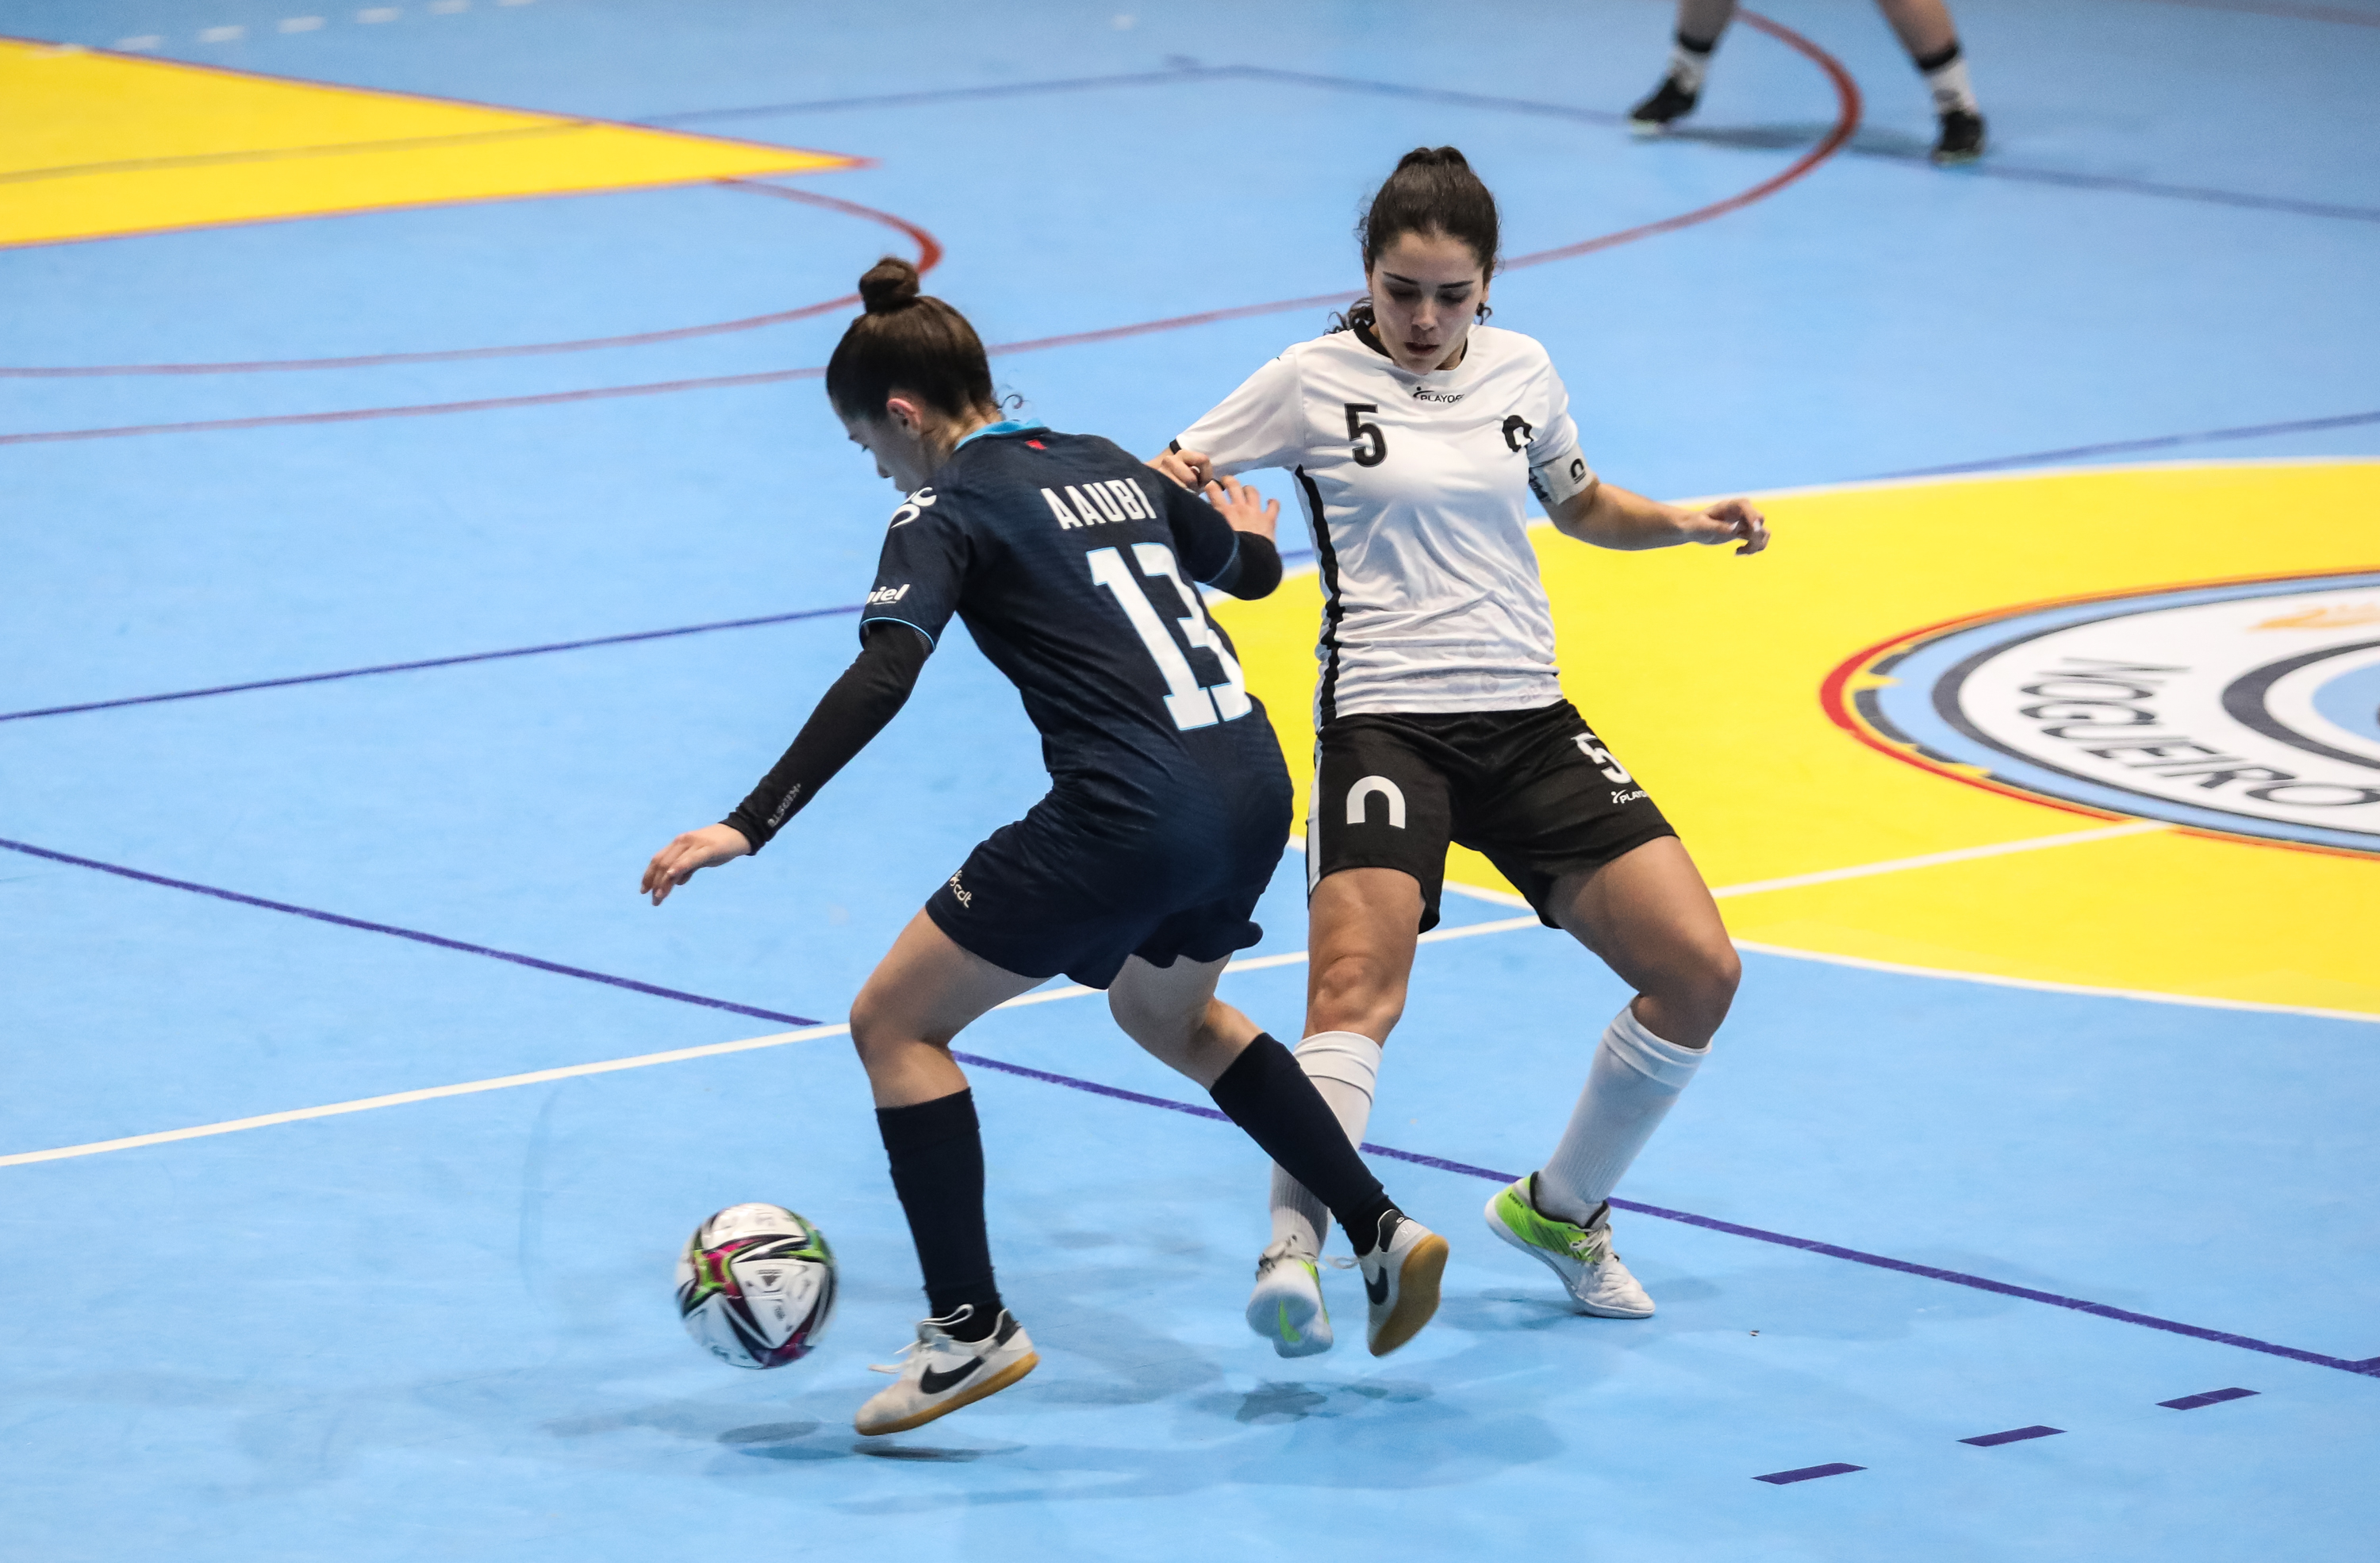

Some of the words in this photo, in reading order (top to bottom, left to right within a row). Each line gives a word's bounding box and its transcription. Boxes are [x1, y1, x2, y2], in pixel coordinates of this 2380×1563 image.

[1344, 402, 1388, 468] 5
[1041, 478, 1157, 530] AAUBI
[1087, 542, 1253, 732] 13
[1570, 732, 1633, 784] 5
